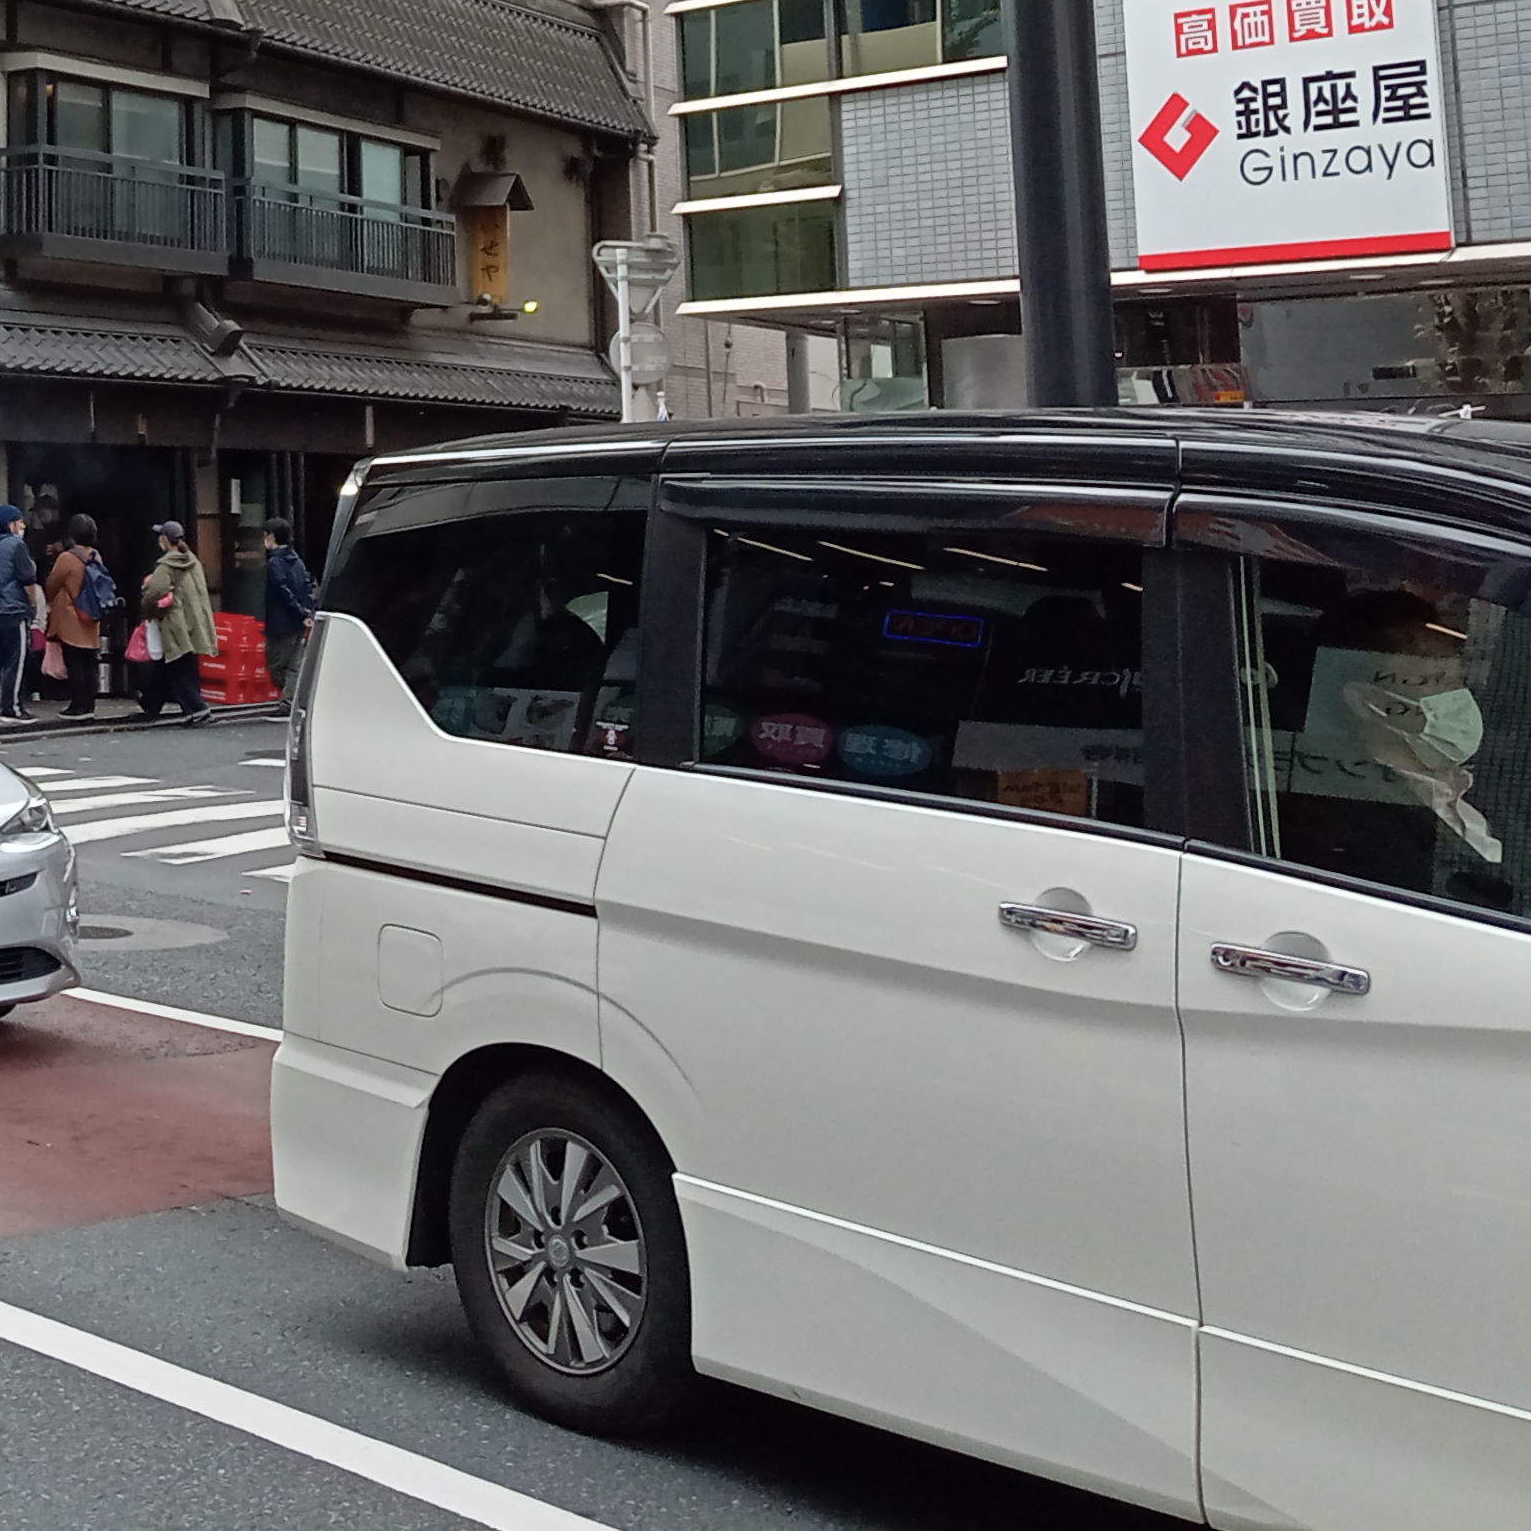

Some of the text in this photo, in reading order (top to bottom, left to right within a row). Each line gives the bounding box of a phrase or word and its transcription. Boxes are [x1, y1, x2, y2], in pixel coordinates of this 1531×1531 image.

[1233, 59, 1432, 141] 銀座屋
[1239, 137, 1436, 187] Ginzaya
